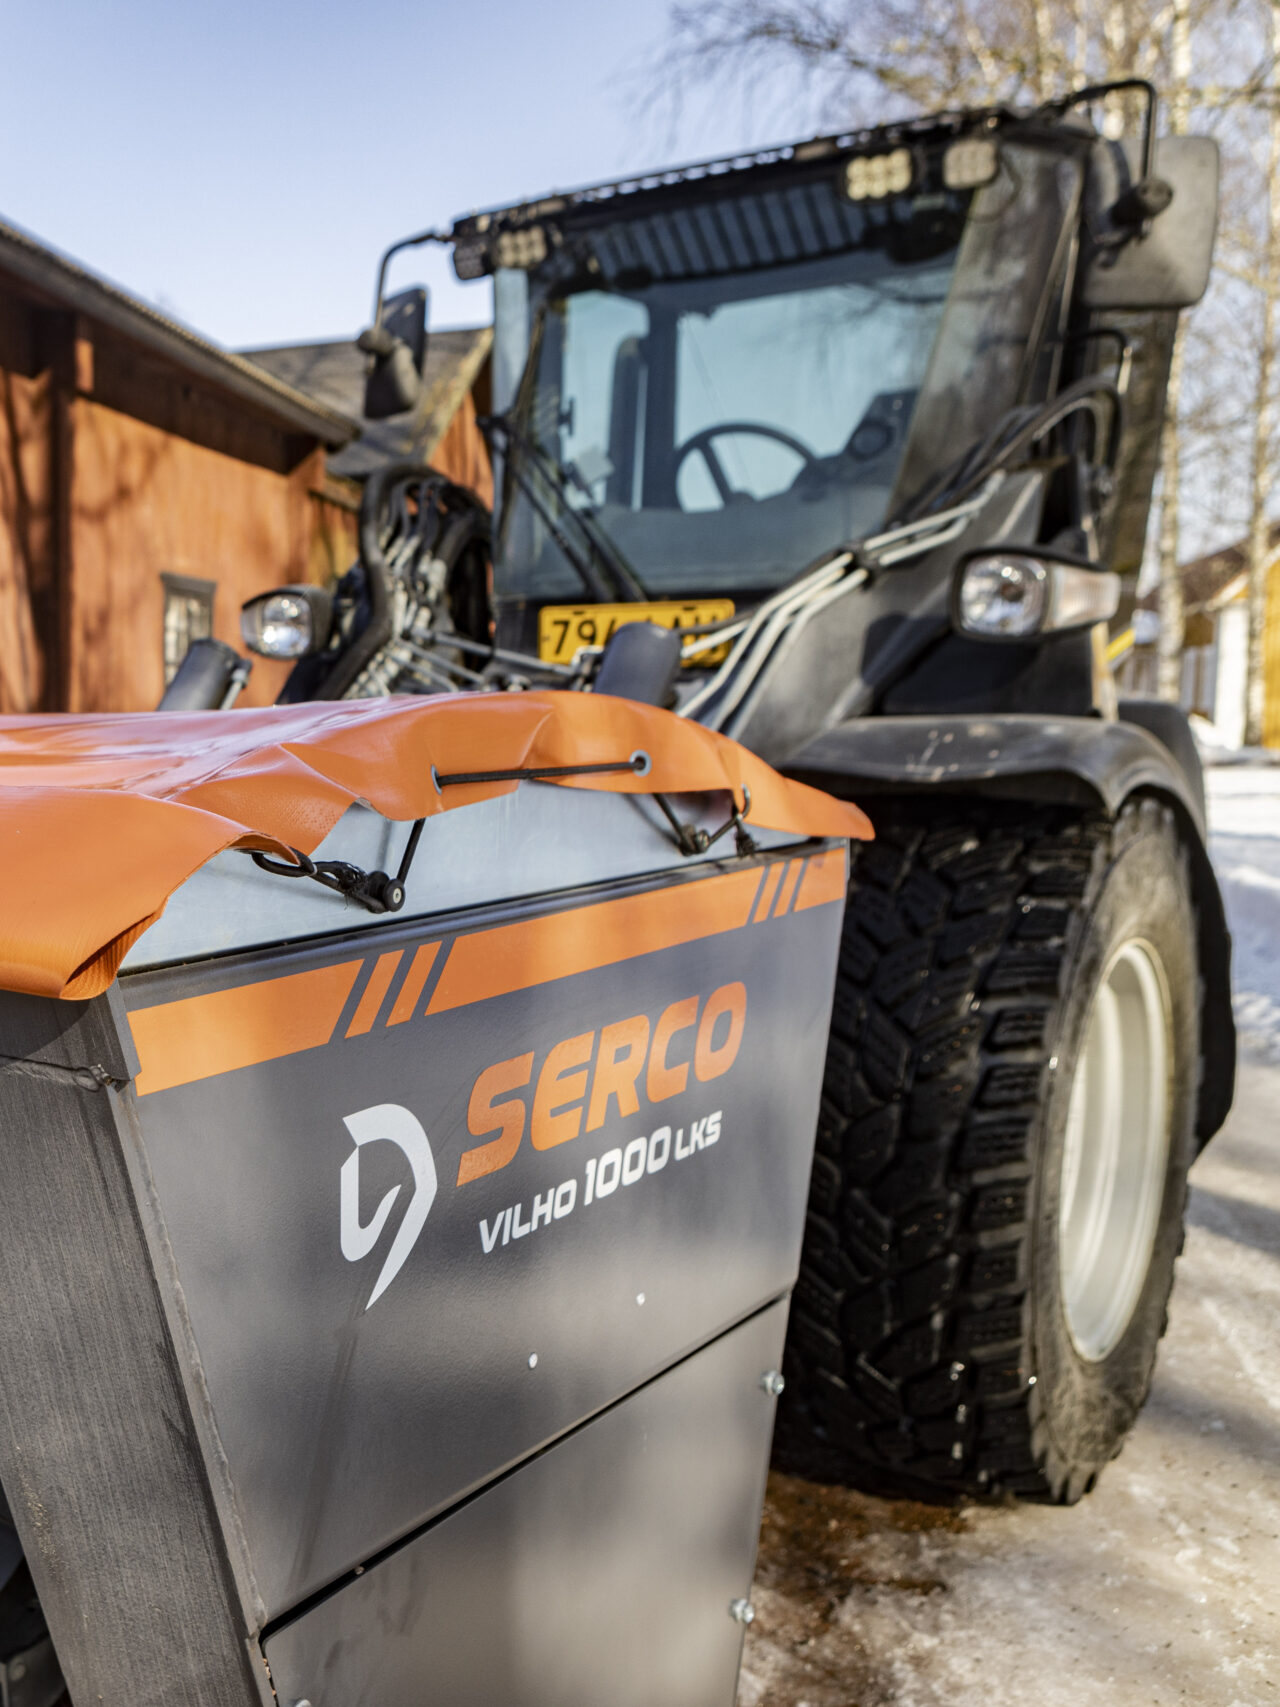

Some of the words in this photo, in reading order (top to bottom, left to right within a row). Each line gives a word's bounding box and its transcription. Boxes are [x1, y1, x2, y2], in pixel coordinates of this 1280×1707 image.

[456, 981, 747, 1187] SERCO
[479, 1179, 577, 1254] VILHO
[584, 1126, 671, 1206] 1000
[674, 1110, 723, 1161] LKS
